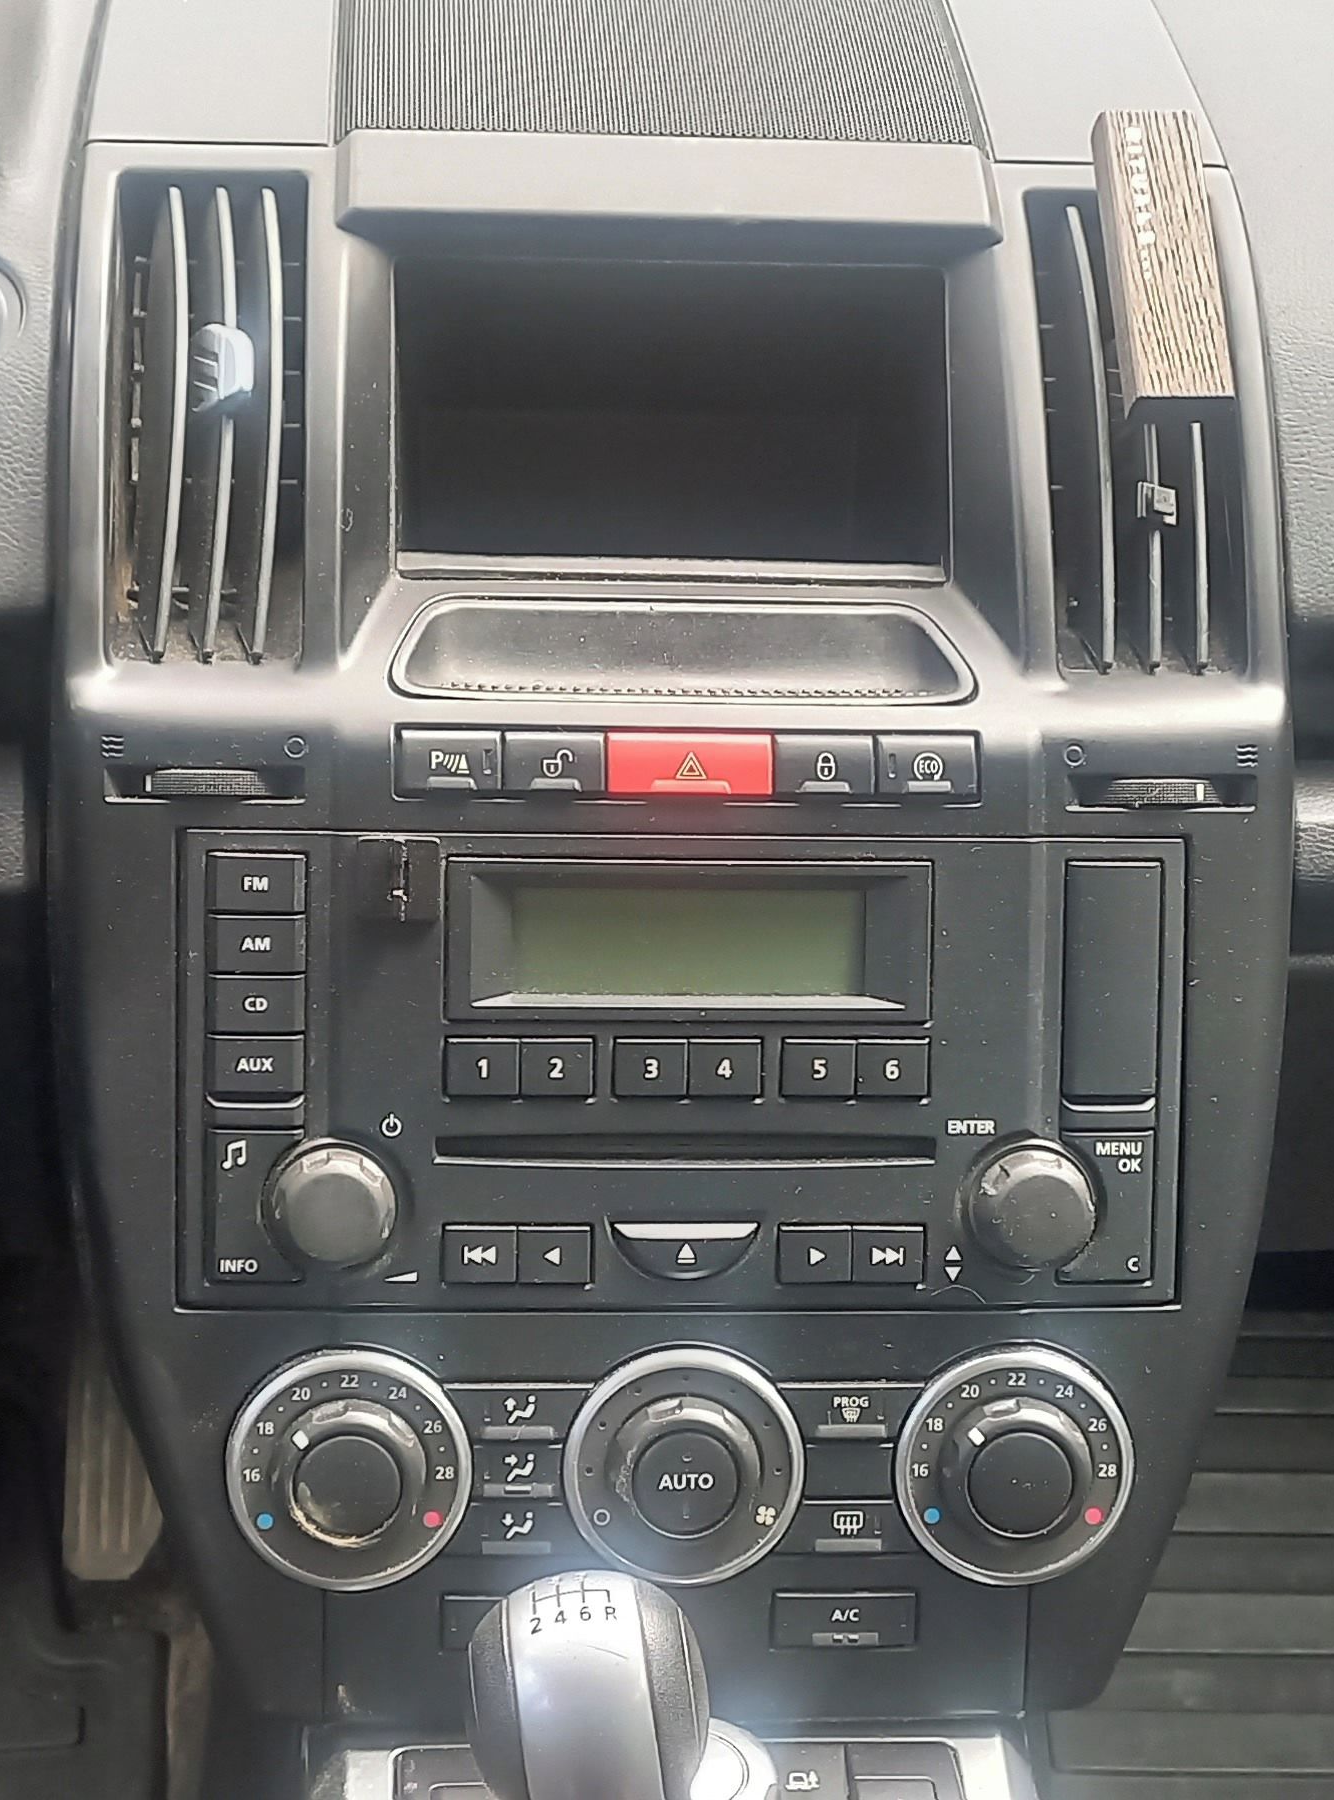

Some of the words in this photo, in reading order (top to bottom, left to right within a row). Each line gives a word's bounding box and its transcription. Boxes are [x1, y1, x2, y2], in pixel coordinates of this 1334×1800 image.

[918, 759, 939, 774] ECO
[242, 876, 269, 892] FM
[240, 936, 271, 952] AM
[243, 997, 269, 1012] CD
[236, 1057, 274, 1072] AUX
[476, 1058, 488, 1079] 1
[548, 1058, 564, 1079] 2
[644, 1058, 659, 1079] 3
[716, 1058, 733, 1079] 4
[812, 1059, 827, 1079] 5
[885, 1059, 900, 1080] 6
[947, 1120, 996, 1135] ENTER
[1095, 1141, 1143, 1156] MENU
[1117, 1158, 1142, 1173] OK
[219, 1258, 258, 1273] INFO
[1127, 1256, 1139, 1272] C
[340, 1374, 359, 1388] 22
[1007, 1372, 1027, 1386] 22
[291, 1387, 311, 1401] 20
[388, 1386, 407, 1400] 24
[960, 1384, 980, 1398] 20
[1055, 1384, 1074, 1398] 24
[833, 1396, 869, 1408] PROG
[256, 1421, 274, 1435] 18
[423, 1420, 442, 1434] 26
[926, 1417, 943, 1432] 18
[1088, 1417, 1107, 1432] 26
[242, 1468, 261, 1482] 16
[435, 1466, 454, 1480] 28
[912, 1463, 929, 1477] 16
[1098, 1463, 1117, 1478] 28
[658, 1473, 714, 1491] AUTO
[554, 1610, 568, 1624] 4
[579, 1606, 592, 1621] 6
[604, 1606, 618, 1621] R
[831, 1607, 860, 1622] A/C
[529, 1617, 543, 1635] 2
